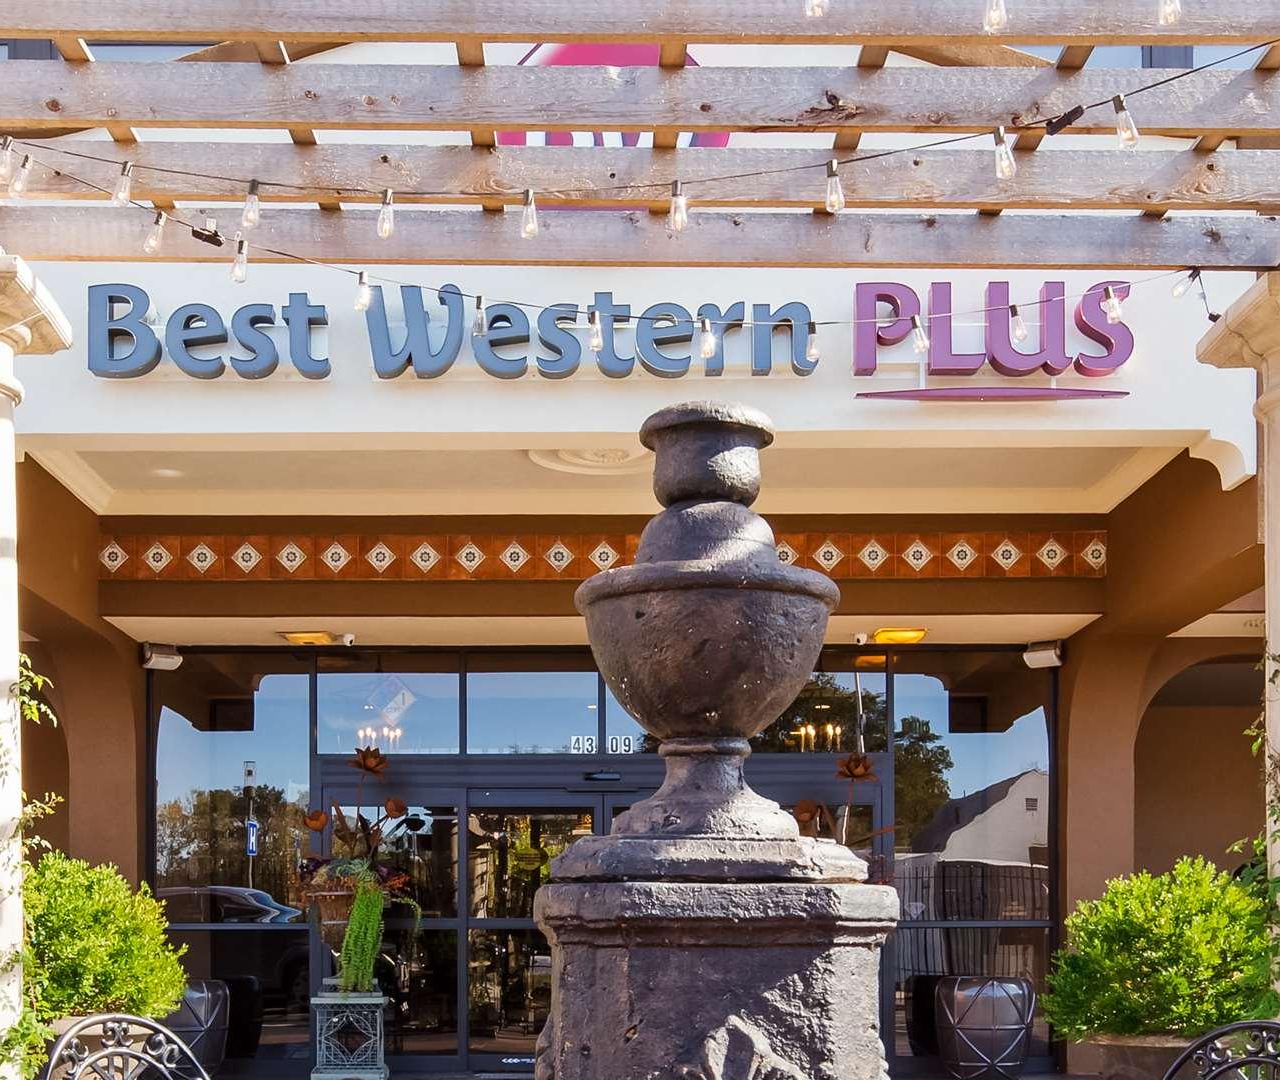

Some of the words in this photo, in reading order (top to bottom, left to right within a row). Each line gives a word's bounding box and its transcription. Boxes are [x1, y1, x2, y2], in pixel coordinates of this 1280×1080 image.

[87, 283, 331, 379] Best
[364, 283, 820, 380] Western
[853, 280, 1136, 378] PLUS
